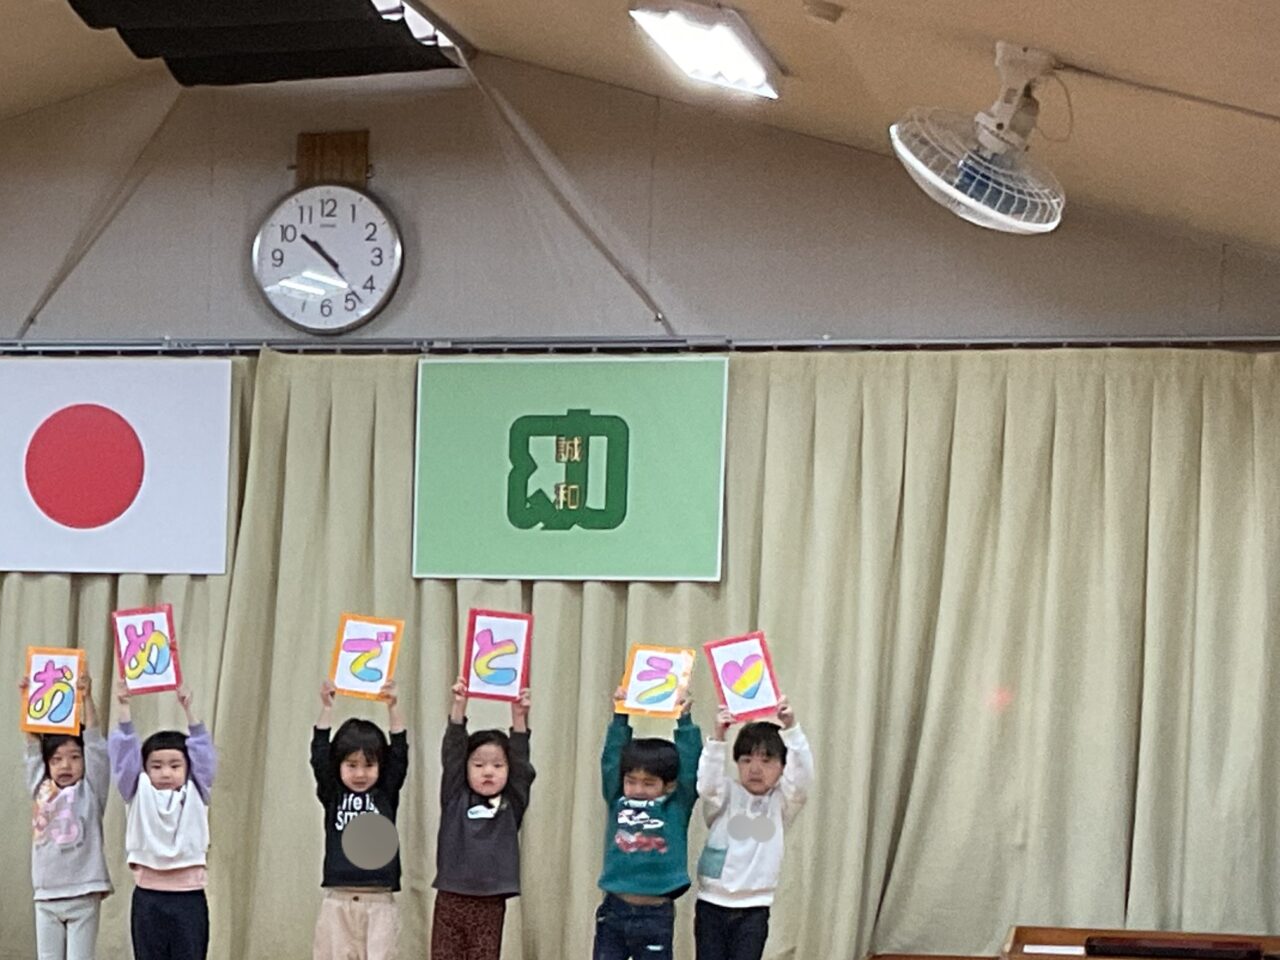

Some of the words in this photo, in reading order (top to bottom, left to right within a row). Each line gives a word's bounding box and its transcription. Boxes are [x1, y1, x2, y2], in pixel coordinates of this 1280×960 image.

[299, 205, 313, 224] 11
[320, 199, 337, 217] 12
[350, 204, 356, 223] 1
[280, 224, 297, 242] 10
[365, 222, 377, 241] 2
[271, 248, 284, 267] 9
[371, 247, 383, 266] 3
[363, 275, 375, 293] 4
[321, 298, 332, 317] 6
[344, 292, 357, 311] 5
[123, 619, 171, 680] め
[342, 630, 394, 682] で
[474, 628, 518, 686] と
[635, 656, 678, 704] う
[27, 659, 75, 723] お
[337, 793, 363, 811] ife
